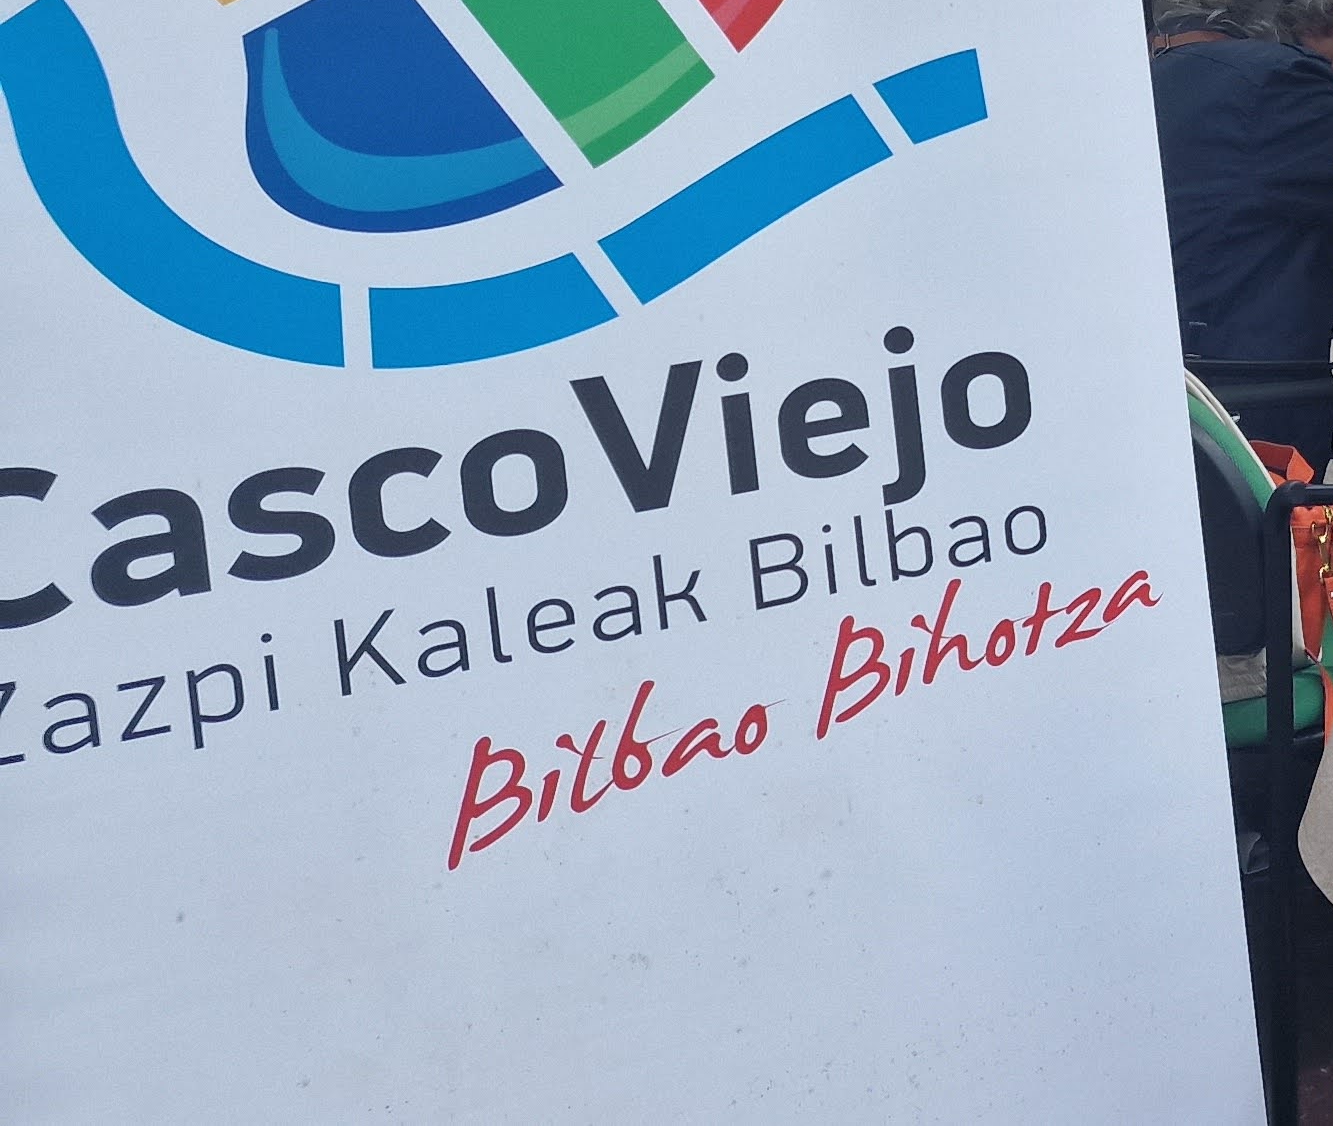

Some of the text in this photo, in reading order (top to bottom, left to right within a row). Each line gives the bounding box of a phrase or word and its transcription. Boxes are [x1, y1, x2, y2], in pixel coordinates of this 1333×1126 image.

[332, 554, 704, 696] Kaleak
[750, 503, 1049, 612] Bilbao
[447, 570, 1163, 871] Bilbao Bihotza
